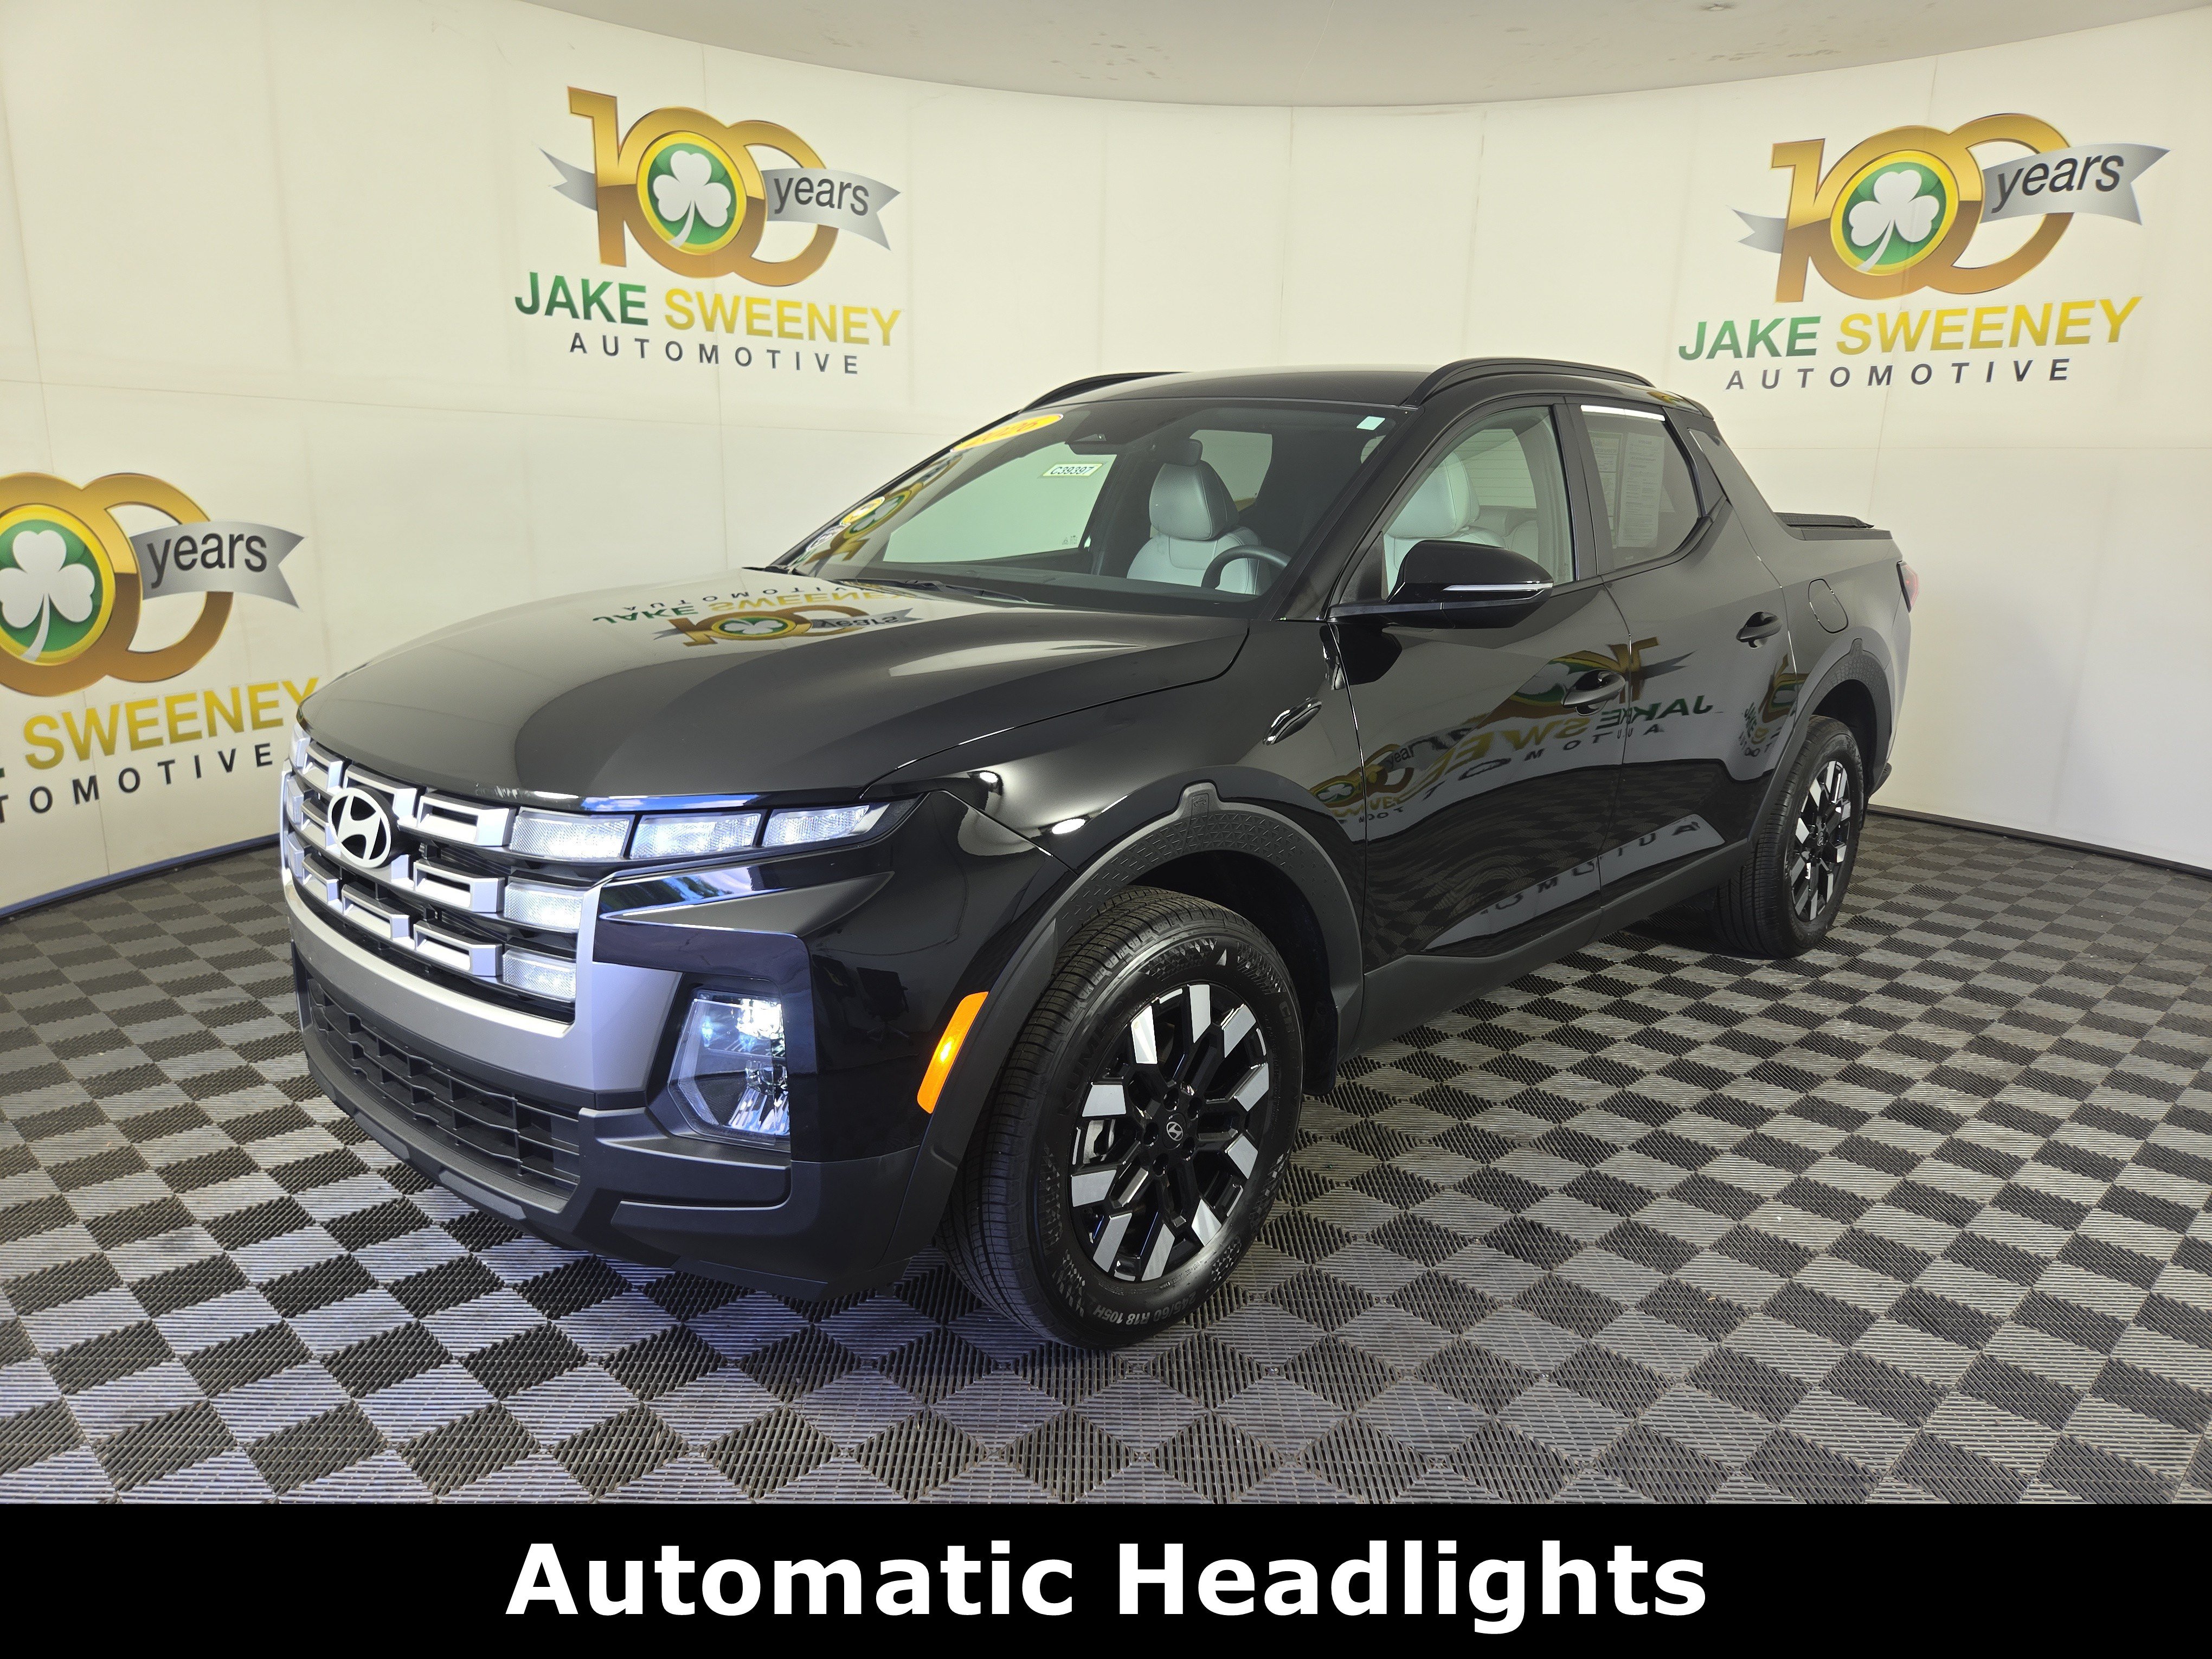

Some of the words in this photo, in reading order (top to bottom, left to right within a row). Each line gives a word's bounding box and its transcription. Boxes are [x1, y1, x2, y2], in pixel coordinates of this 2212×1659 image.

[567, 86, 839, 287] 100
[774, 175, 870, 217] years
[1770, 113, 2076, 303] 100
[1991, 154, 2124, 214] years
[515, 271, 649, 326] JAKE
[665, 288, 902, 346] SWEENEY
[1679, 316, 1821, 361] JAKE
[1836, 296, 2142, 356] SWEENEY
[570, 332, 858, 375] AUTOMOTIVE
[1726, 358, 2070, 390] AUTOMOTIVE
[1050, 466, 1095, 475] C39397
[147, 532, 268, 589] years
[23, 677, 319, 770] SWEENEY
[1056, 998, 1126, 1116] KUMHO
[1092, 1304, 1124, 1324] 105H
[1126, 1312, 1151, 1325] R18
[1152, 1291, 1197, 1322] 245/60
